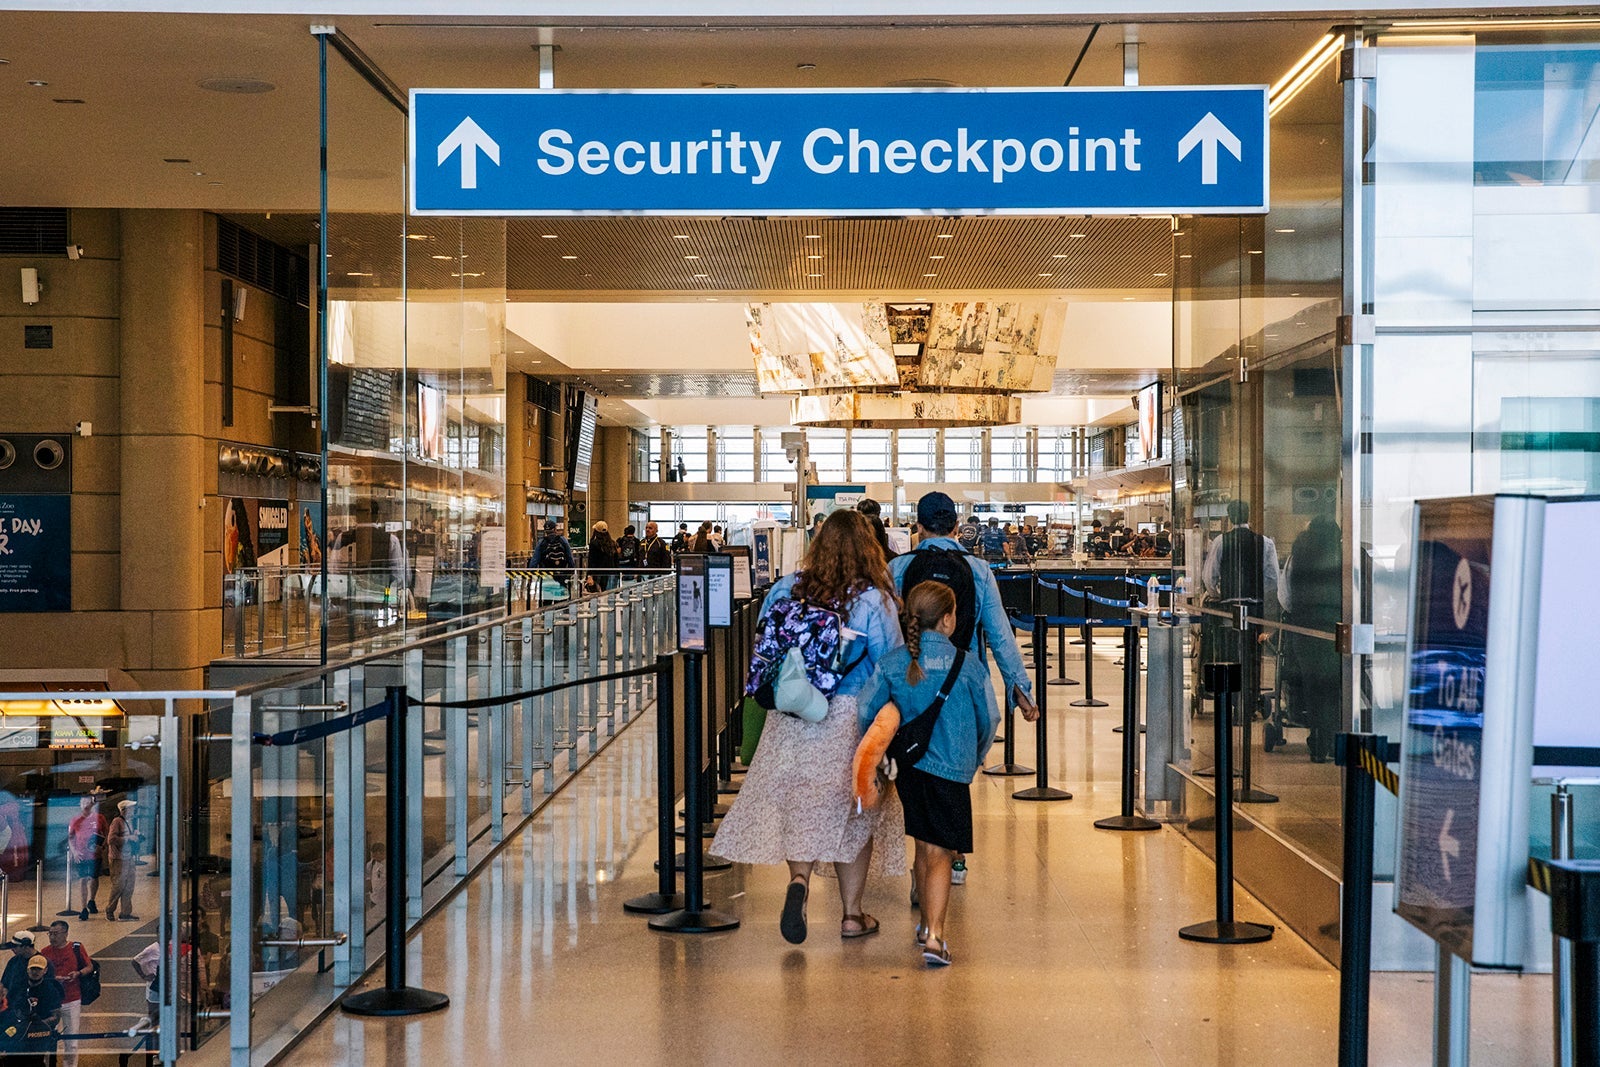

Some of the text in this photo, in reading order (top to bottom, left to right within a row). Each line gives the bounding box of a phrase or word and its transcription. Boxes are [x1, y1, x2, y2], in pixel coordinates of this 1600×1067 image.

[537, 127, 1142, 185] Security Checkpoint
[12, 518, 43, 536] DAY.
[259, 506, 287, 529] SMUGGLED
[1437, 660, 1479, 714] To All
[13, 735, 33, 746] C32
[1433, 721, 1475, 780] Gates
